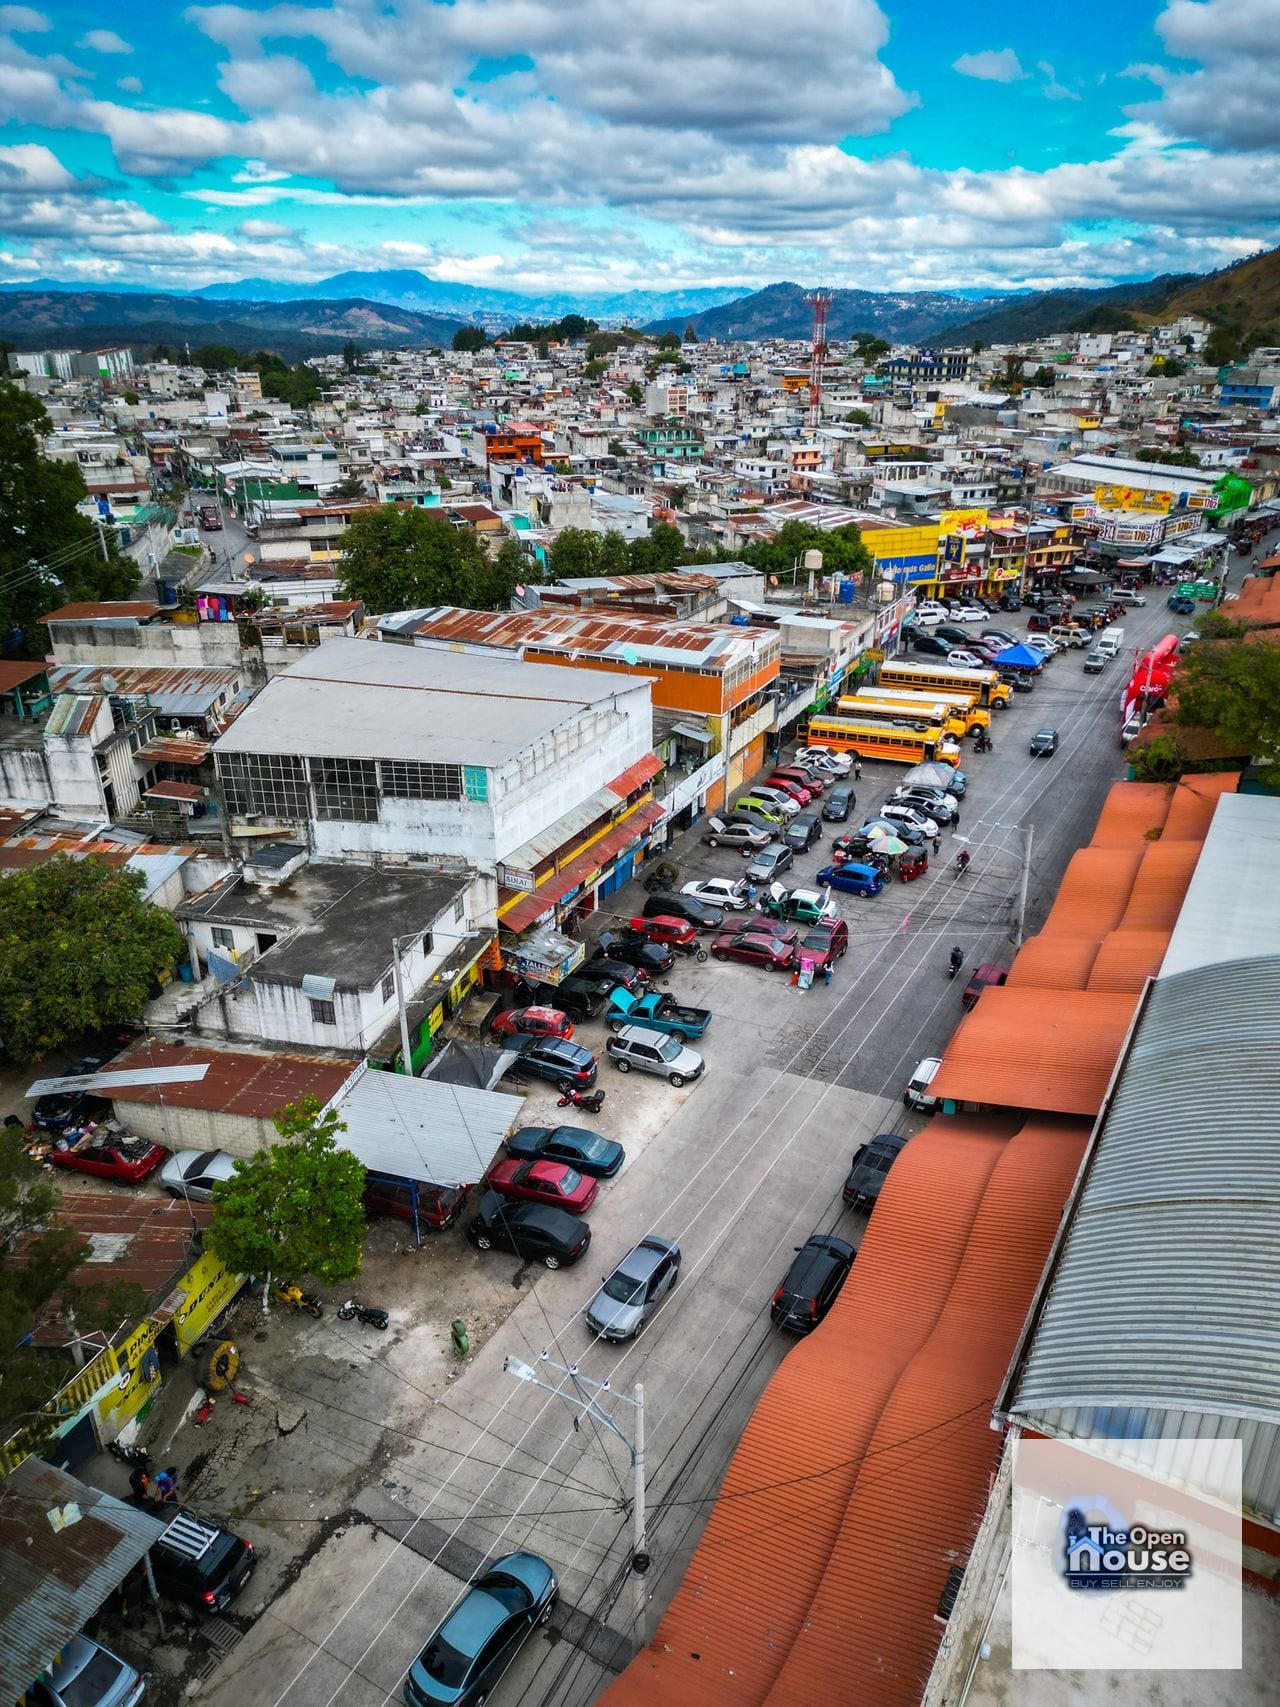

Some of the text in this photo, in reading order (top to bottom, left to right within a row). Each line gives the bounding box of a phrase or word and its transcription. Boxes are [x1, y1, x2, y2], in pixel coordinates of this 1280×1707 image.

[1205, 498, 1217, 508] 1702
[1106, 525, 1114, 539] 24
[1178, 521, 1193, 532] 1702
[1134, 530, 1150, 541] 1702
[919, 563, 935, 571] Gallo
[525, 960, 551, 973] TALLER
